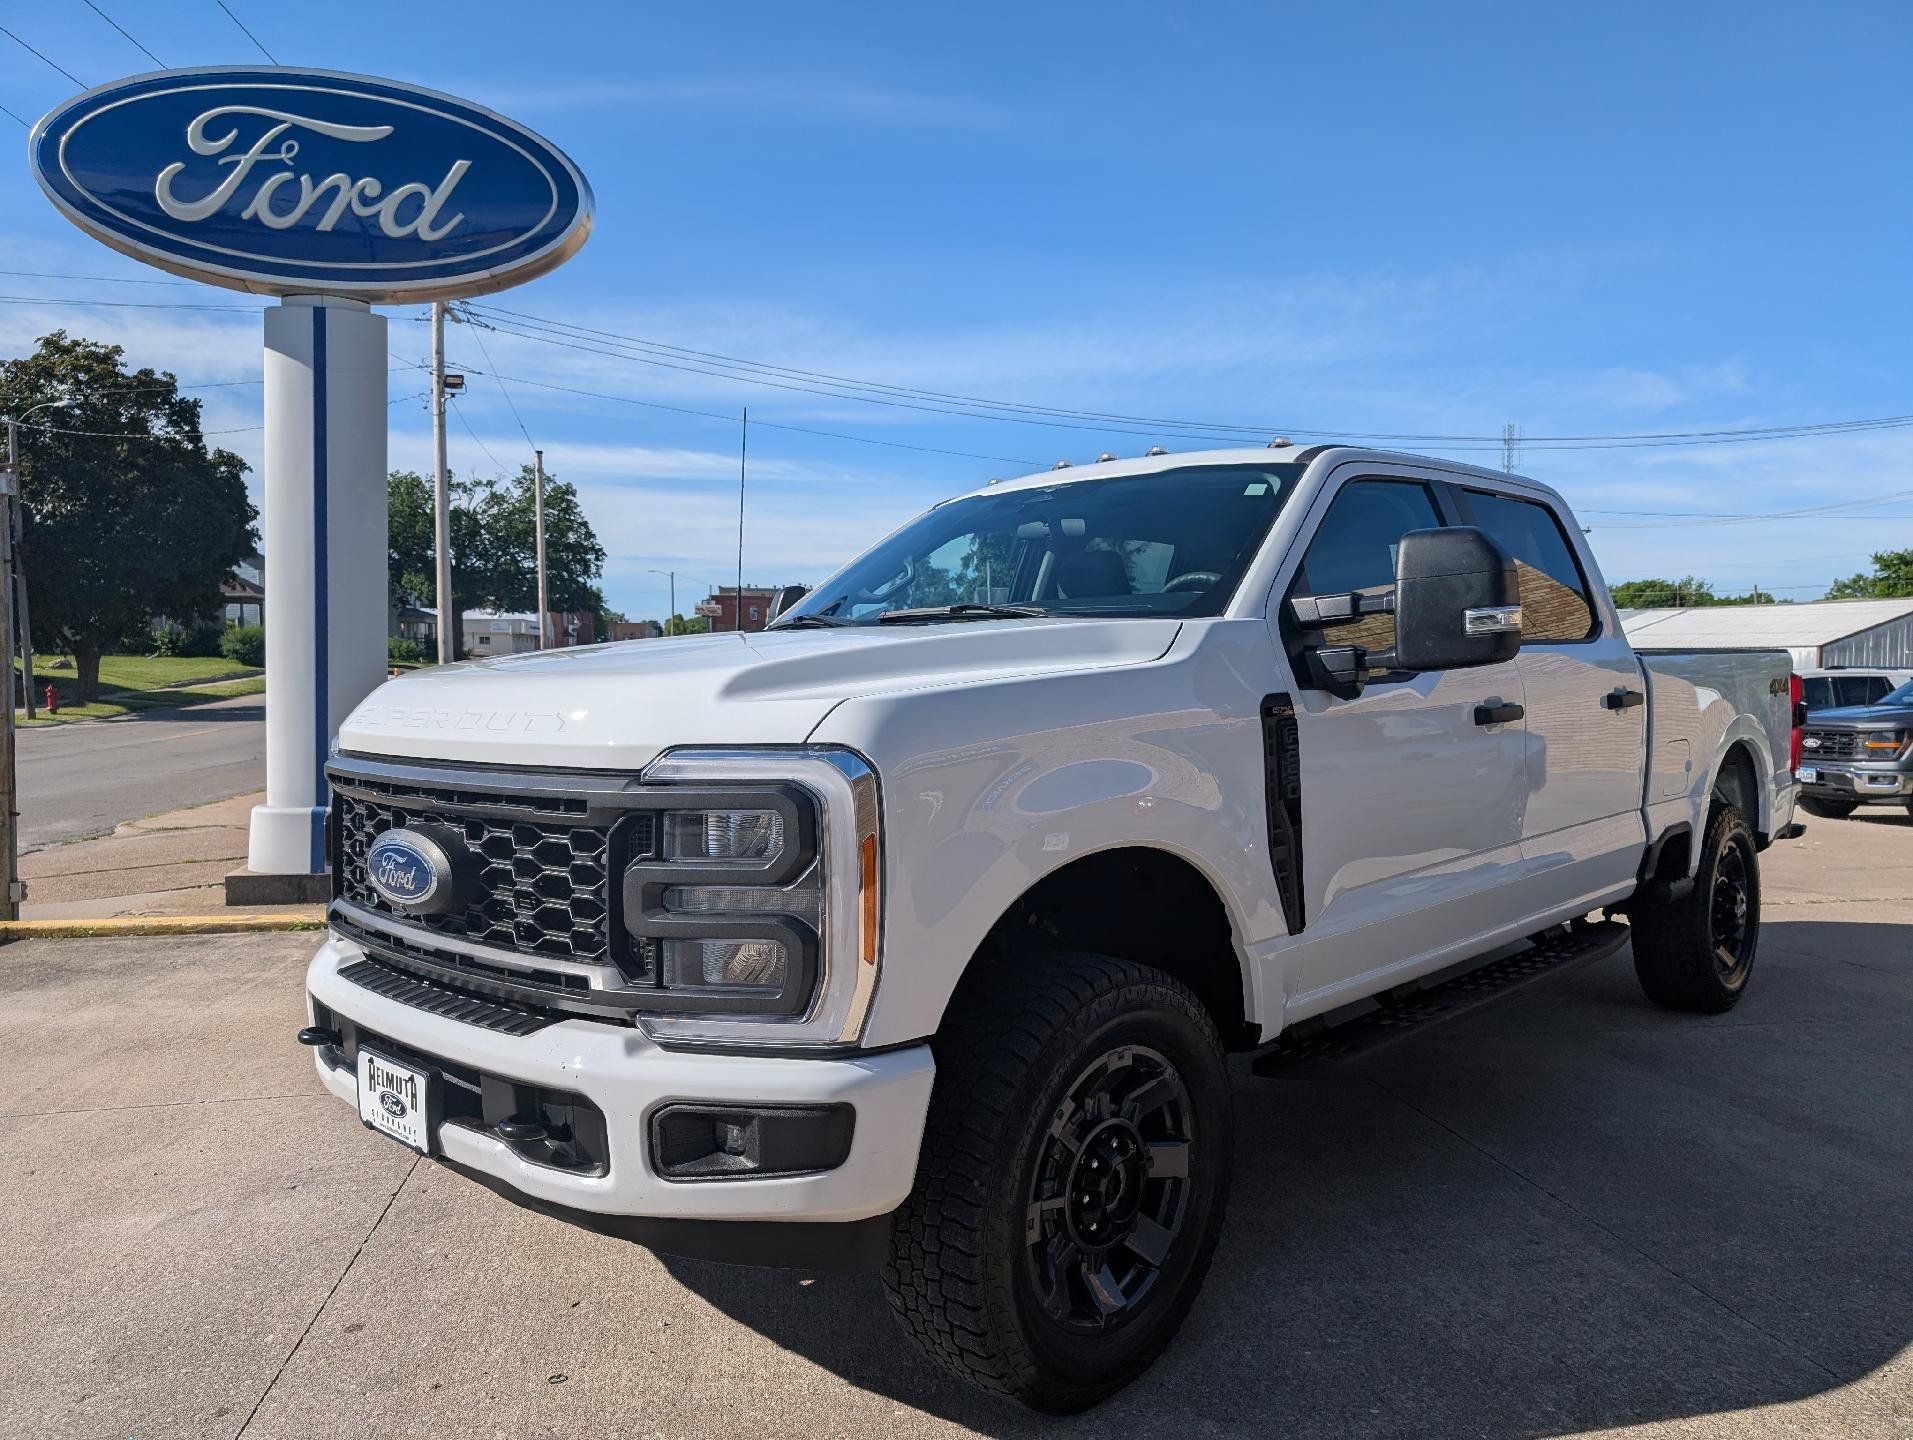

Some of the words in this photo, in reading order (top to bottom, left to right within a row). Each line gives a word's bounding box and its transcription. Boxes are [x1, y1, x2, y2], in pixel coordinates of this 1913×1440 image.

[156, 105, 472, 241] Ford
[454, 709, 568, 733] DUTY
[379, 852, 416, 891] Ford
[367, 1057, 417, 1113] HELMUTH
[383, 1093, 402, 1114] Ford
